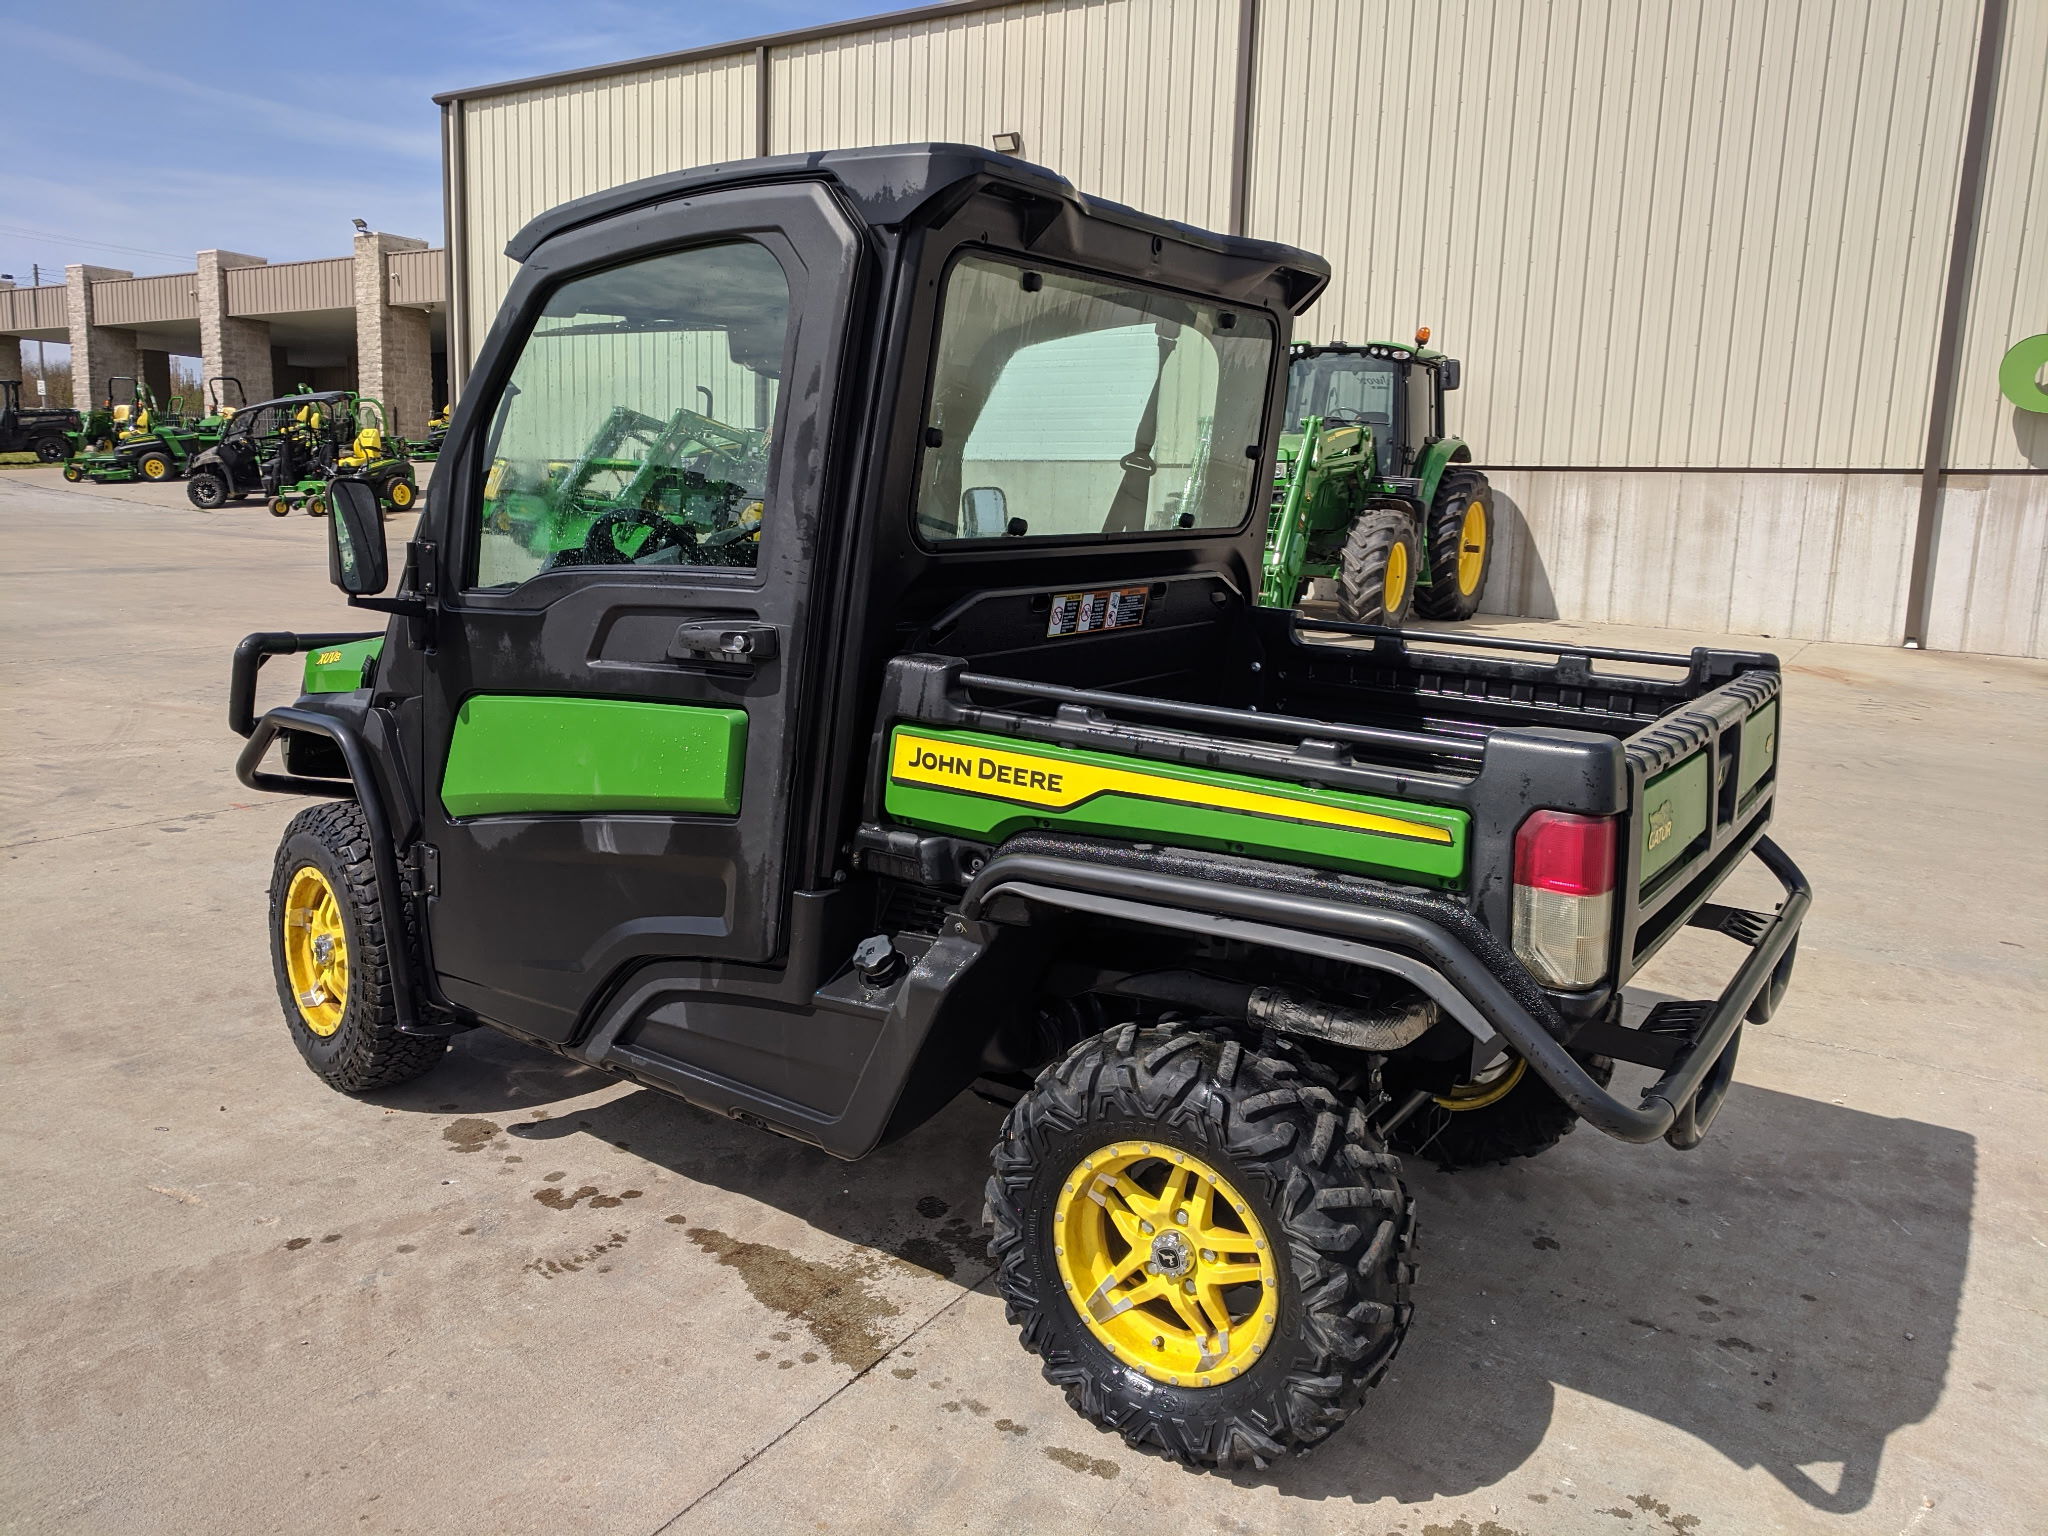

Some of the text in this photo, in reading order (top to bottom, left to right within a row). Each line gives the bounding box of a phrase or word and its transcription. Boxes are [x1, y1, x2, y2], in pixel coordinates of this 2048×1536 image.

[908, 747, 1063, 793] JOHN DEERE
[1648, 820, 1673, 851] GATOR
